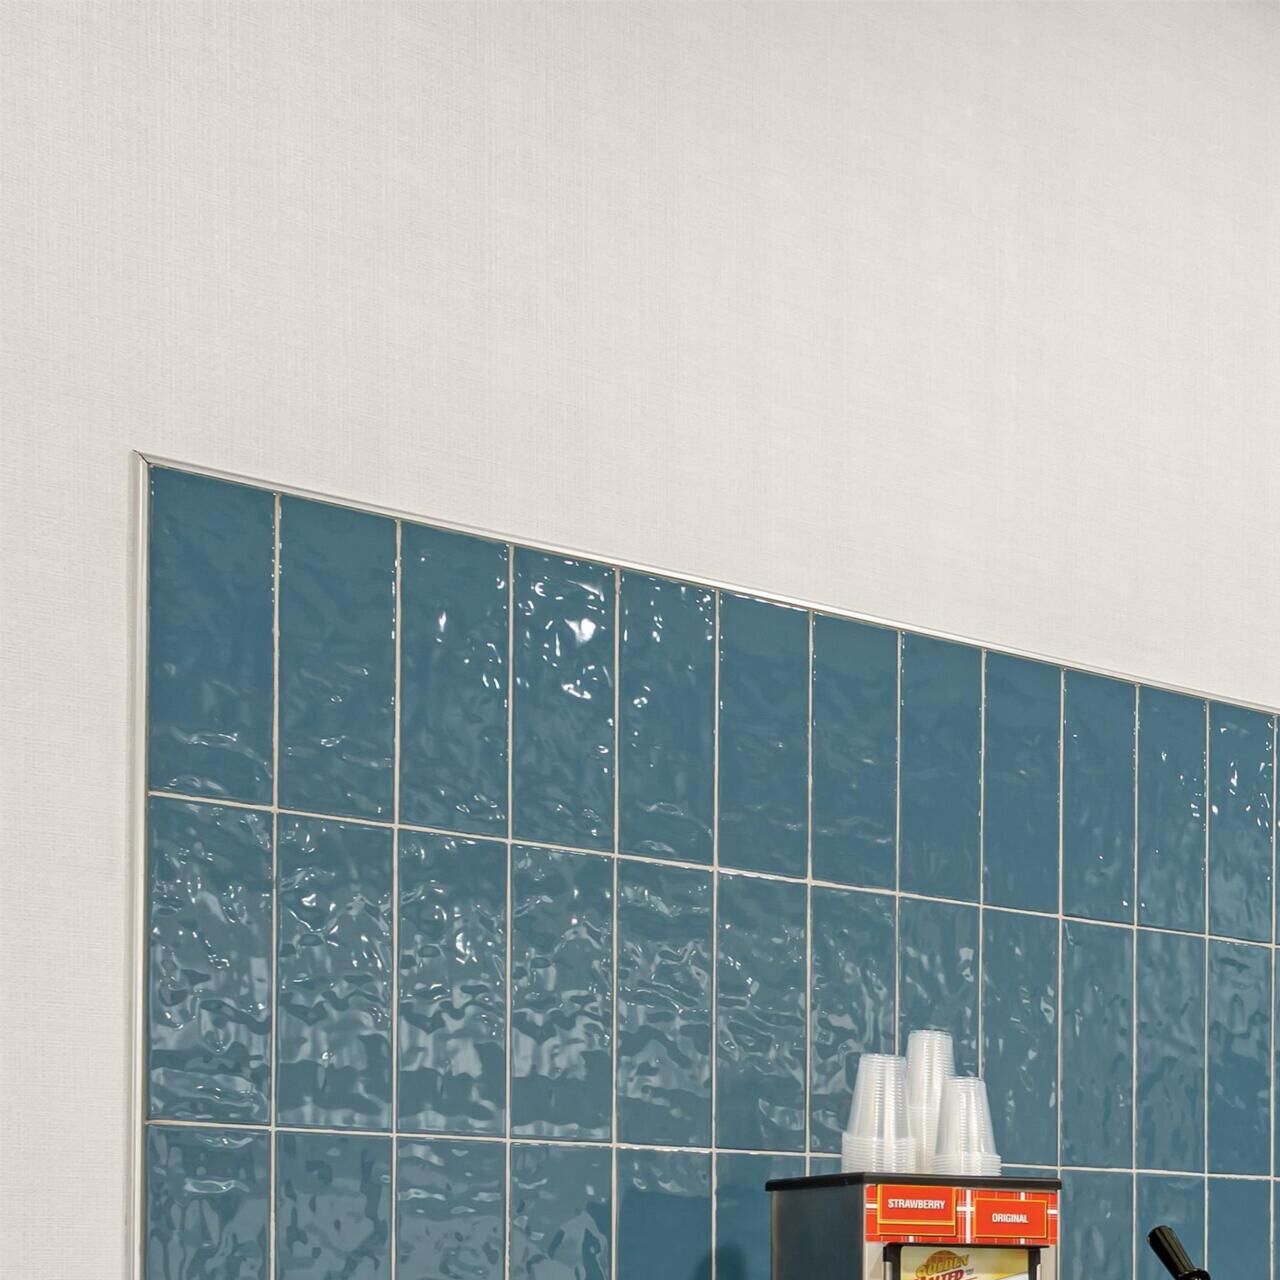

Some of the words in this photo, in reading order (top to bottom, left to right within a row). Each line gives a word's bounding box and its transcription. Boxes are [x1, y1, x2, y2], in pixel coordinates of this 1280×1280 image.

[887, 1198, 946, 1209] STRAWBERRY
[991, 1212, 1029, 1224] ORIGINAL
[915, 1254, 970, 1278] GOLDEN
